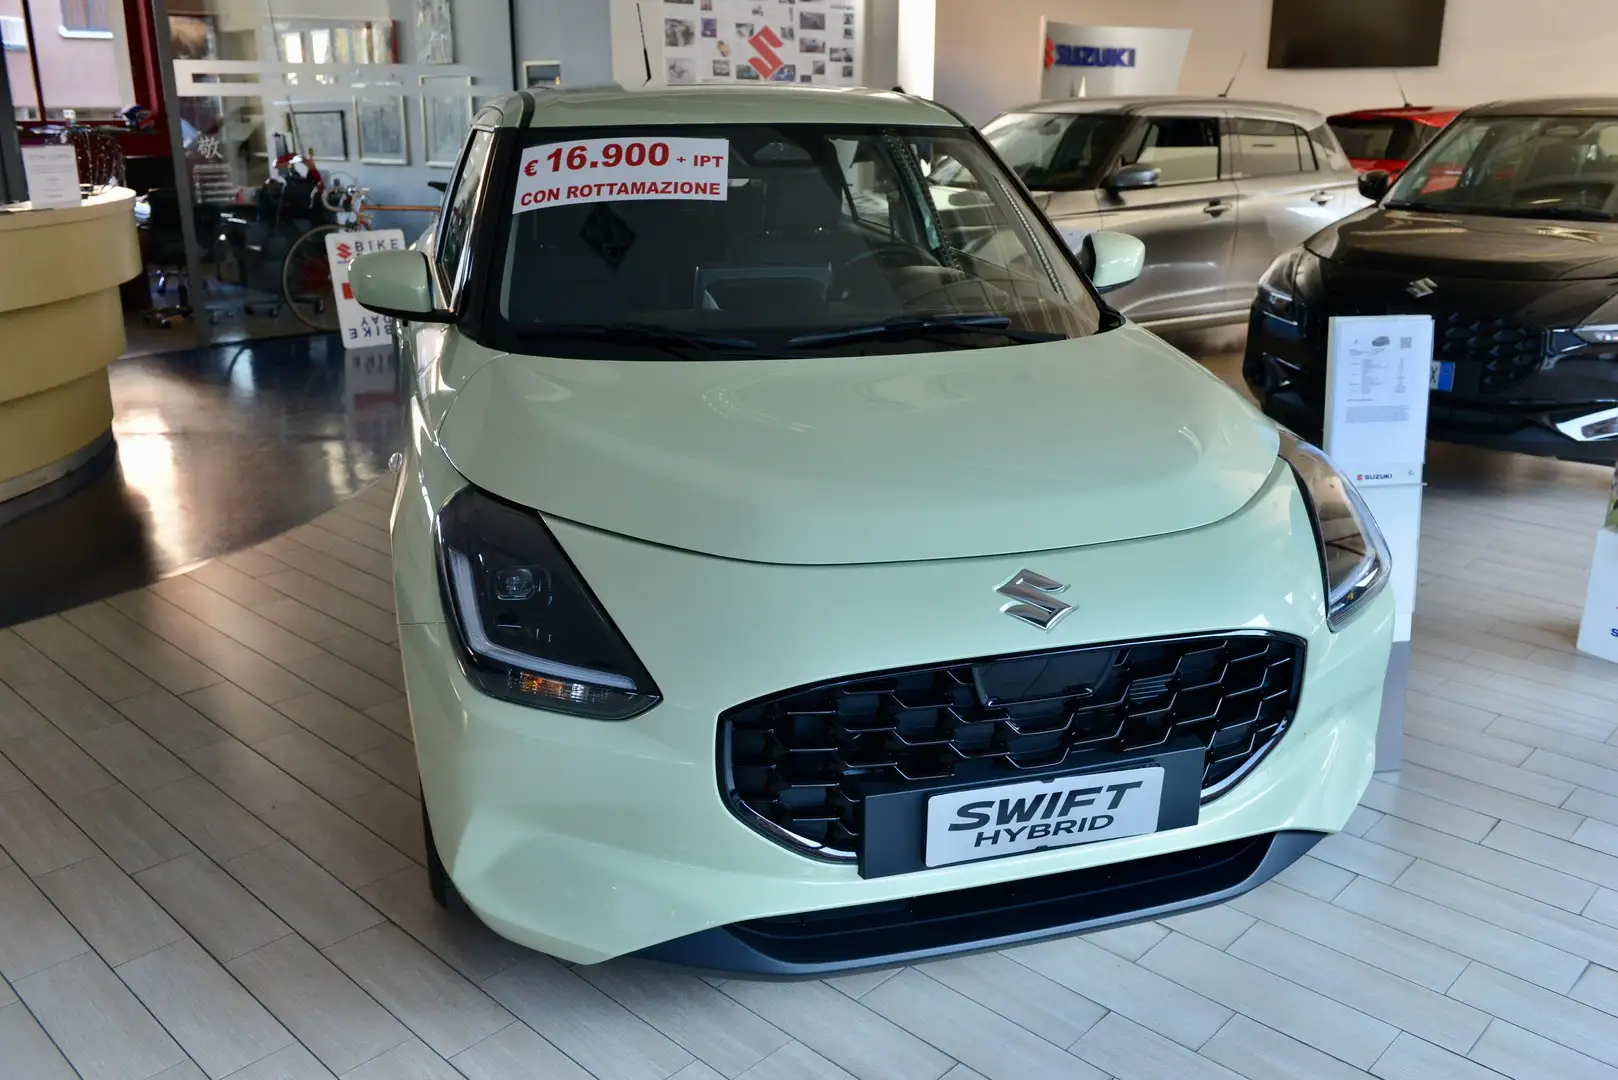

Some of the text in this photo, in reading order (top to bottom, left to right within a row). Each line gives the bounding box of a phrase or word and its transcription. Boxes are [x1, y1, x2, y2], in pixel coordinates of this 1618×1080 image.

[1055, 44, 1136, 67] SUZUKI
[524, 142, 724, 177] € 16.900 + IPT
[520, 181, 721, 206] CON ROTTAMAZIONE
[354, 238, 400, 252] BIKE
[948, 780, 1143, 831] SWIFT
[974, 814, 1115, 847] HYBRID
